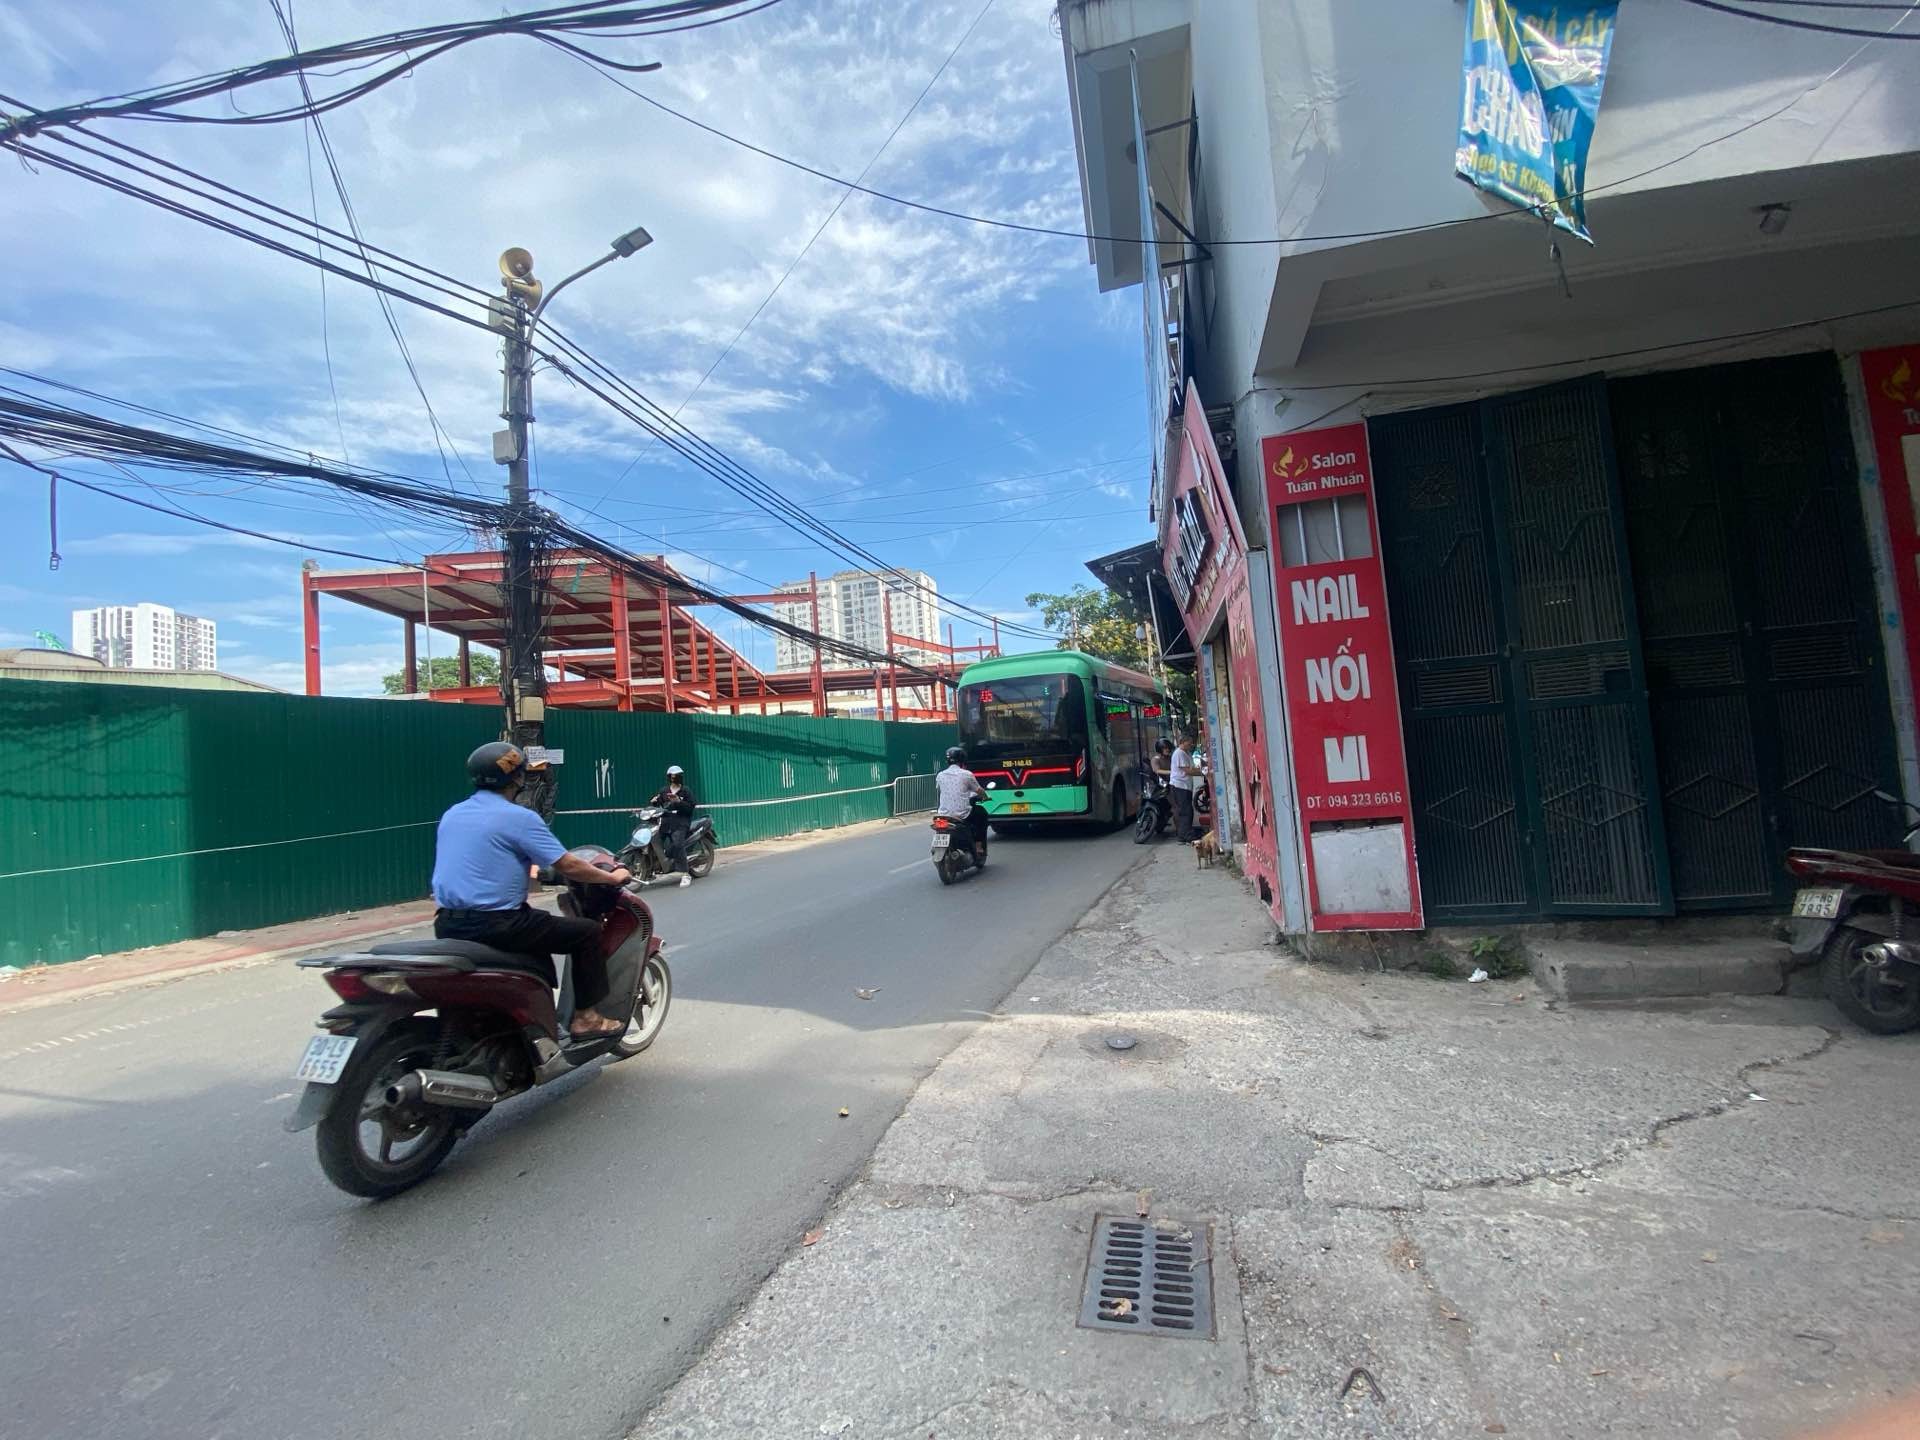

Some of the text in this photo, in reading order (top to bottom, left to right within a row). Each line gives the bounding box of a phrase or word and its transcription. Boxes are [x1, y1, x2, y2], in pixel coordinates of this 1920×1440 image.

[1311, 452, 1356, 470] Salon
[1291, 574, 1370, 626] NAIL
[1305, 637, 1371, 704] NỐI
[1323, 735, 1371, 783] MI
[1328, 795, 1348, 808] 094
[1351, 793, 1372, 806] 323
[1374, 791, 1402, 805] 6616
